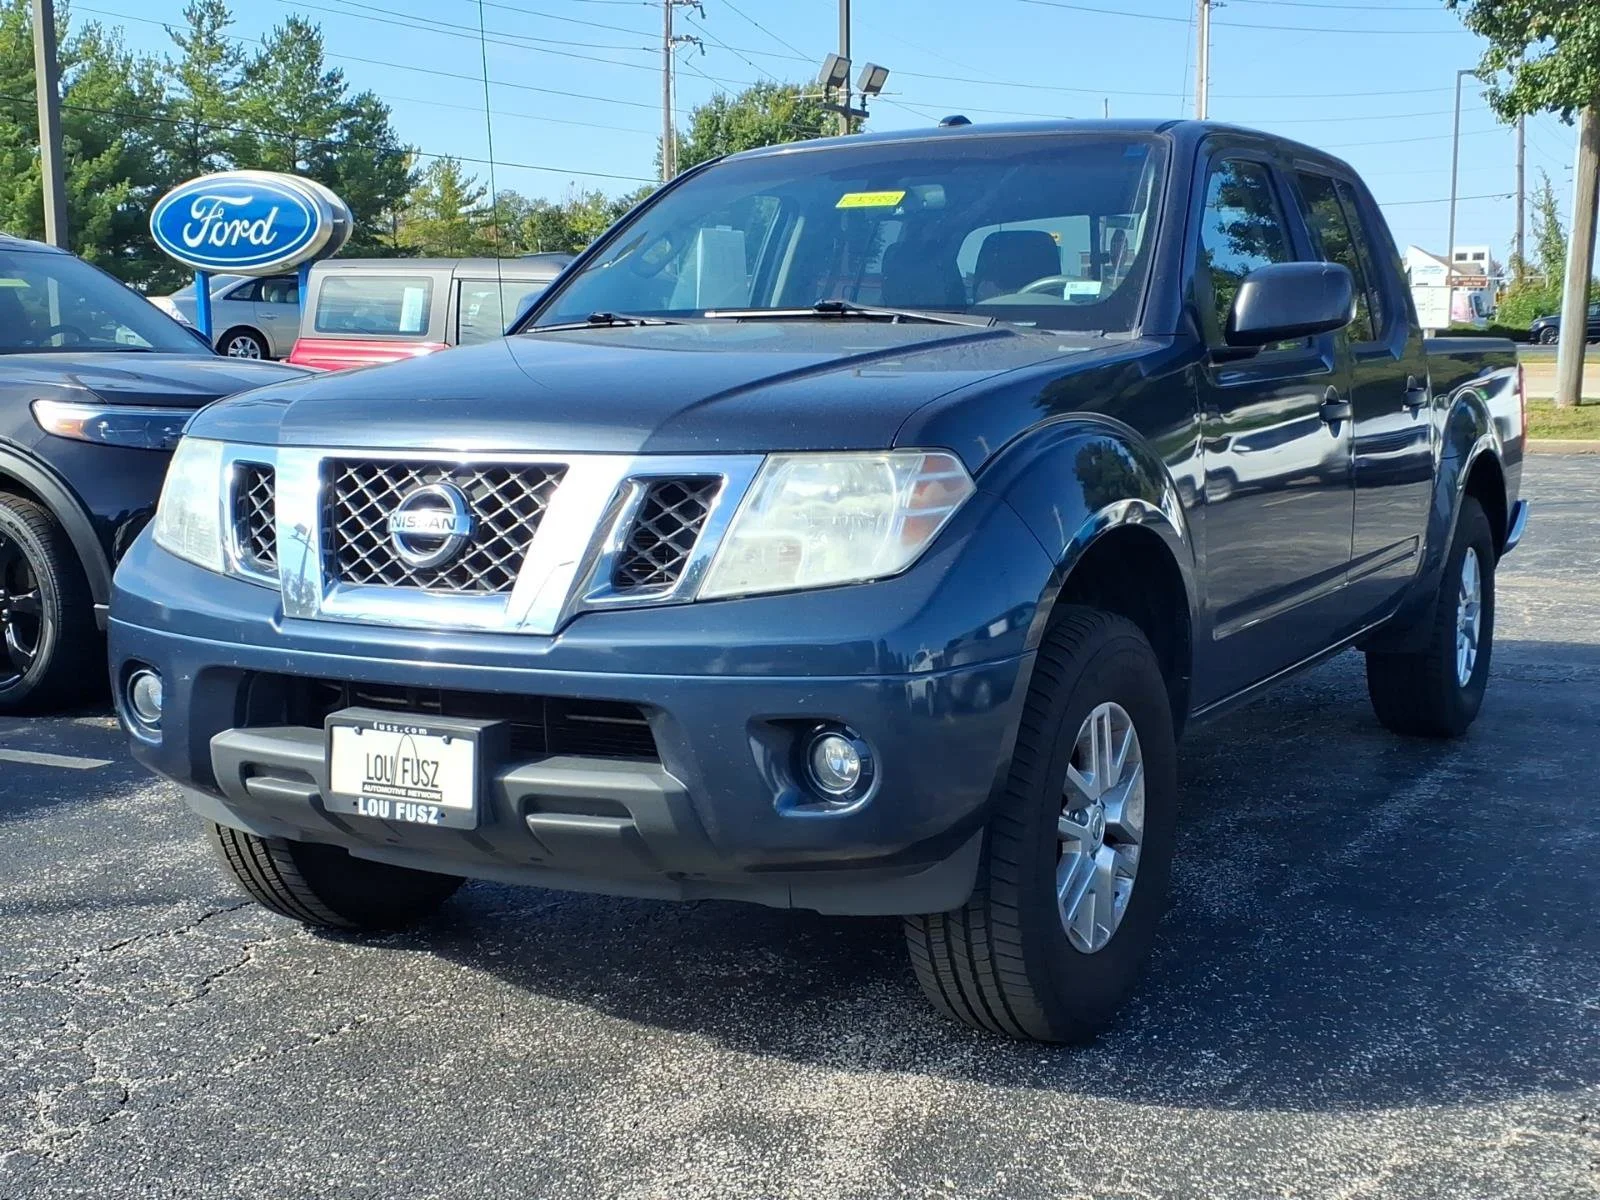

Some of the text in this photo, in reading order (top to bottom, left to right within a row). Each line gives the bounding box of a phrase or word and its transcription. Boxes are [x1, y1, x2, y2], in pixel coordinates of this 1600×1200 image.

[183, 195, 279, 248] Ford
[373, 721, 428, 735] fusz.com
[366, 752, 439, 788] LOU FUSZ
[363, 784, 407, 797] AUTOMOTIVE
[358, 797, 439, 825] LOU FUSZ
